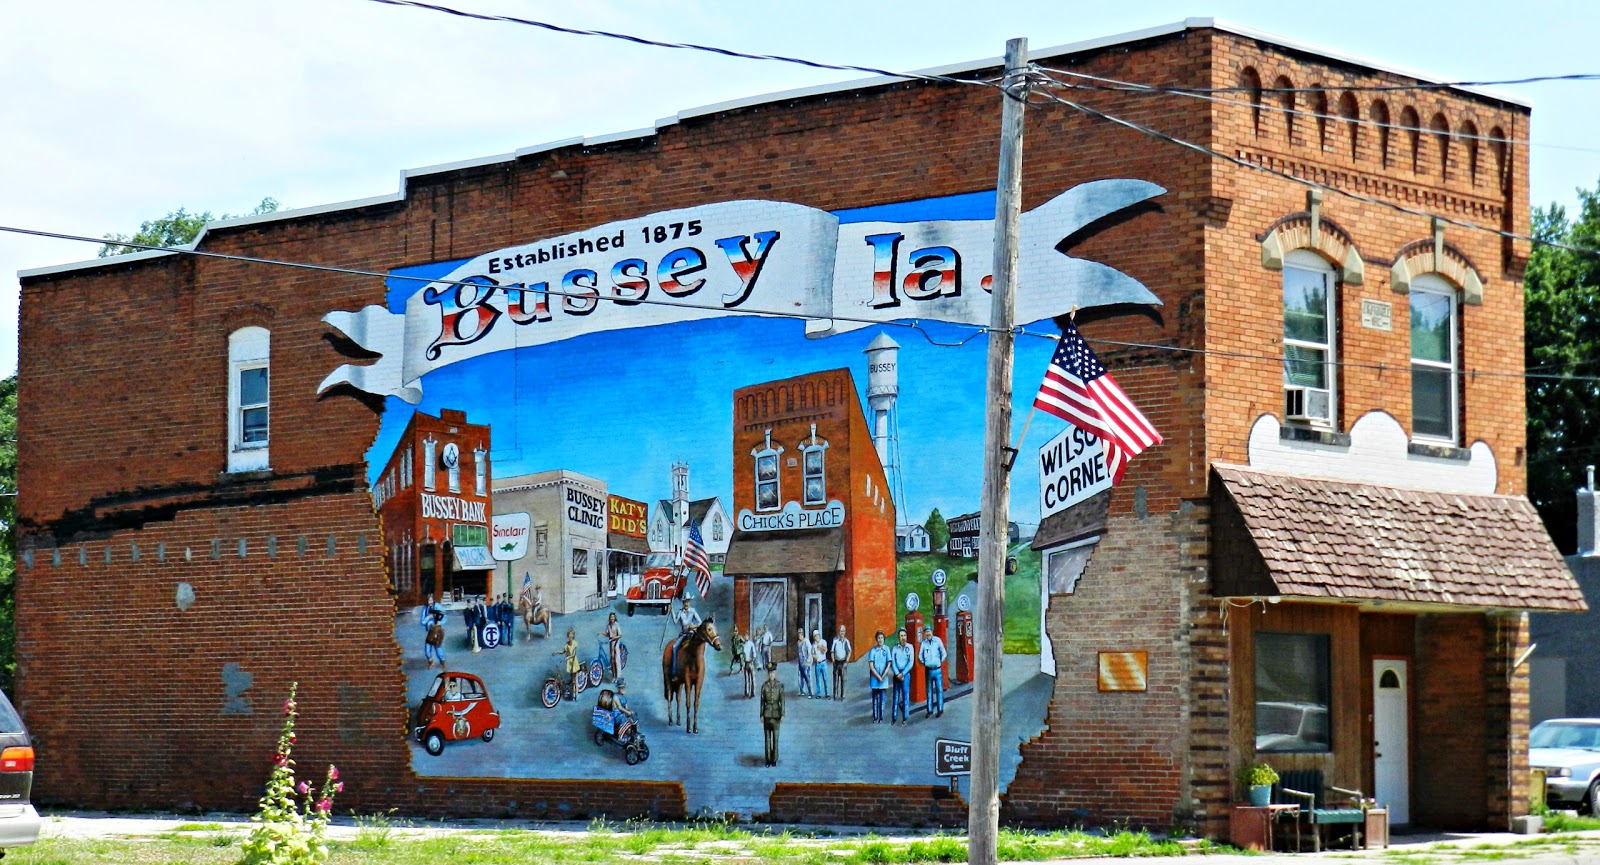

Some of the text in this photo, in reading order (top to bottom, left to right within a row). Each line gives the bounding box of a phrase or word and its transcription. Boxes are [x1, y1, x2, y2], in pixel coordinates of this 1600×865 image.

[489, 219, 703, 274] Established 1875
[424, 230, 781, 361] Bussey
[869, 362, 896, 374] BUSSEY
[1041, 425, 1098, 476] WILSO
[1044, 451, 1111, 509] CORNE
[420, 492, 487, 523] BUSSEY BANK
[567, 487, 606, 515] BUSSEY
[609, 497, 646, 518] KATY
[568, 506, 604, 529] CLINIC
[610, 514, 647, 535] DID'S
[742, 507, 841, 530] CHICK'S PLACE
[492, 524, 527, 538] Sinclair
[943, 754, 970, 763] Creek
[944, 745, 968, 753] Bluff
